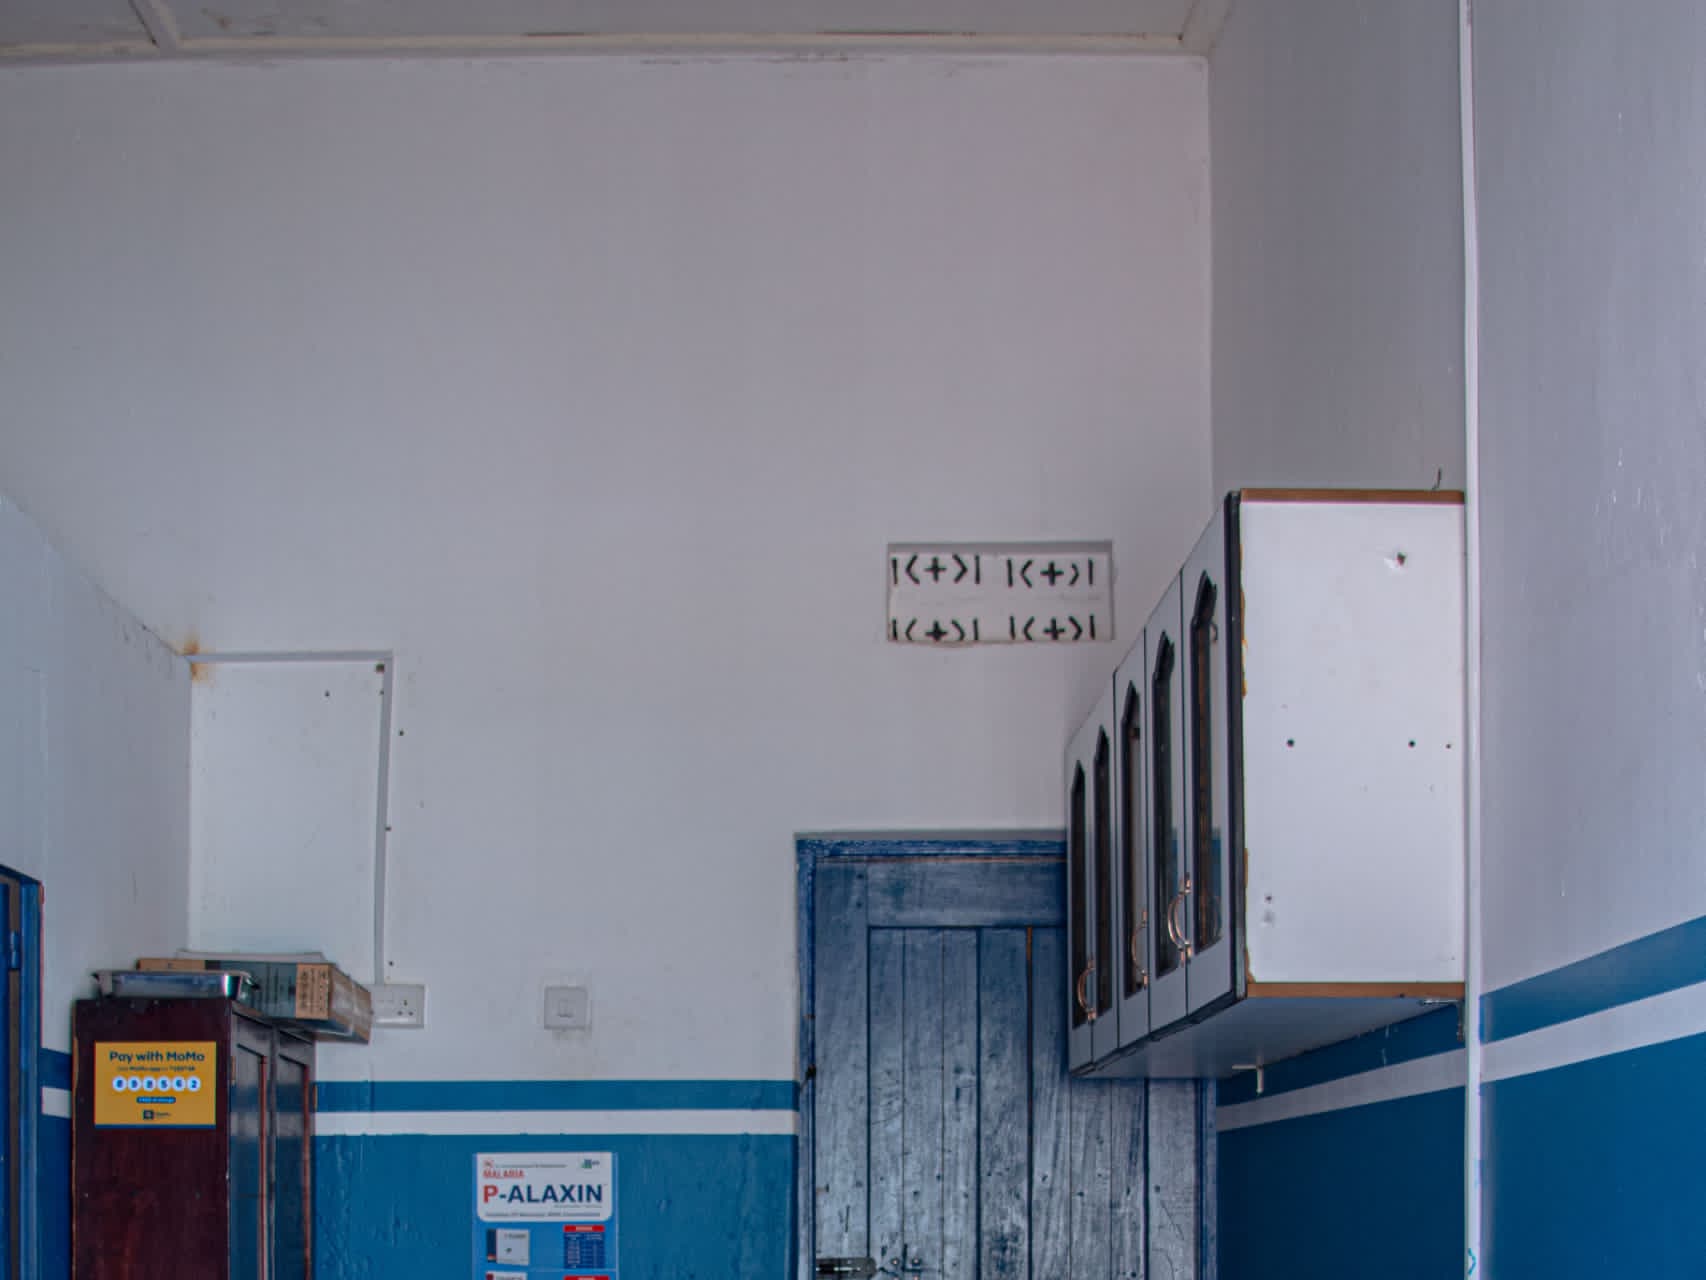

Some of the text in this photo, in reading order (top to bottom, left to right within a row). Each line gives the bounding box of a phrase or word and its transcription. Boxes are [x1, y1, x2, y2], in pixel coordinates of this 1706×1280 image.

[109, 1051, 205, 1063] Pay with MoMo
[483, 1183, 603, 1204] P-ALAXIN
